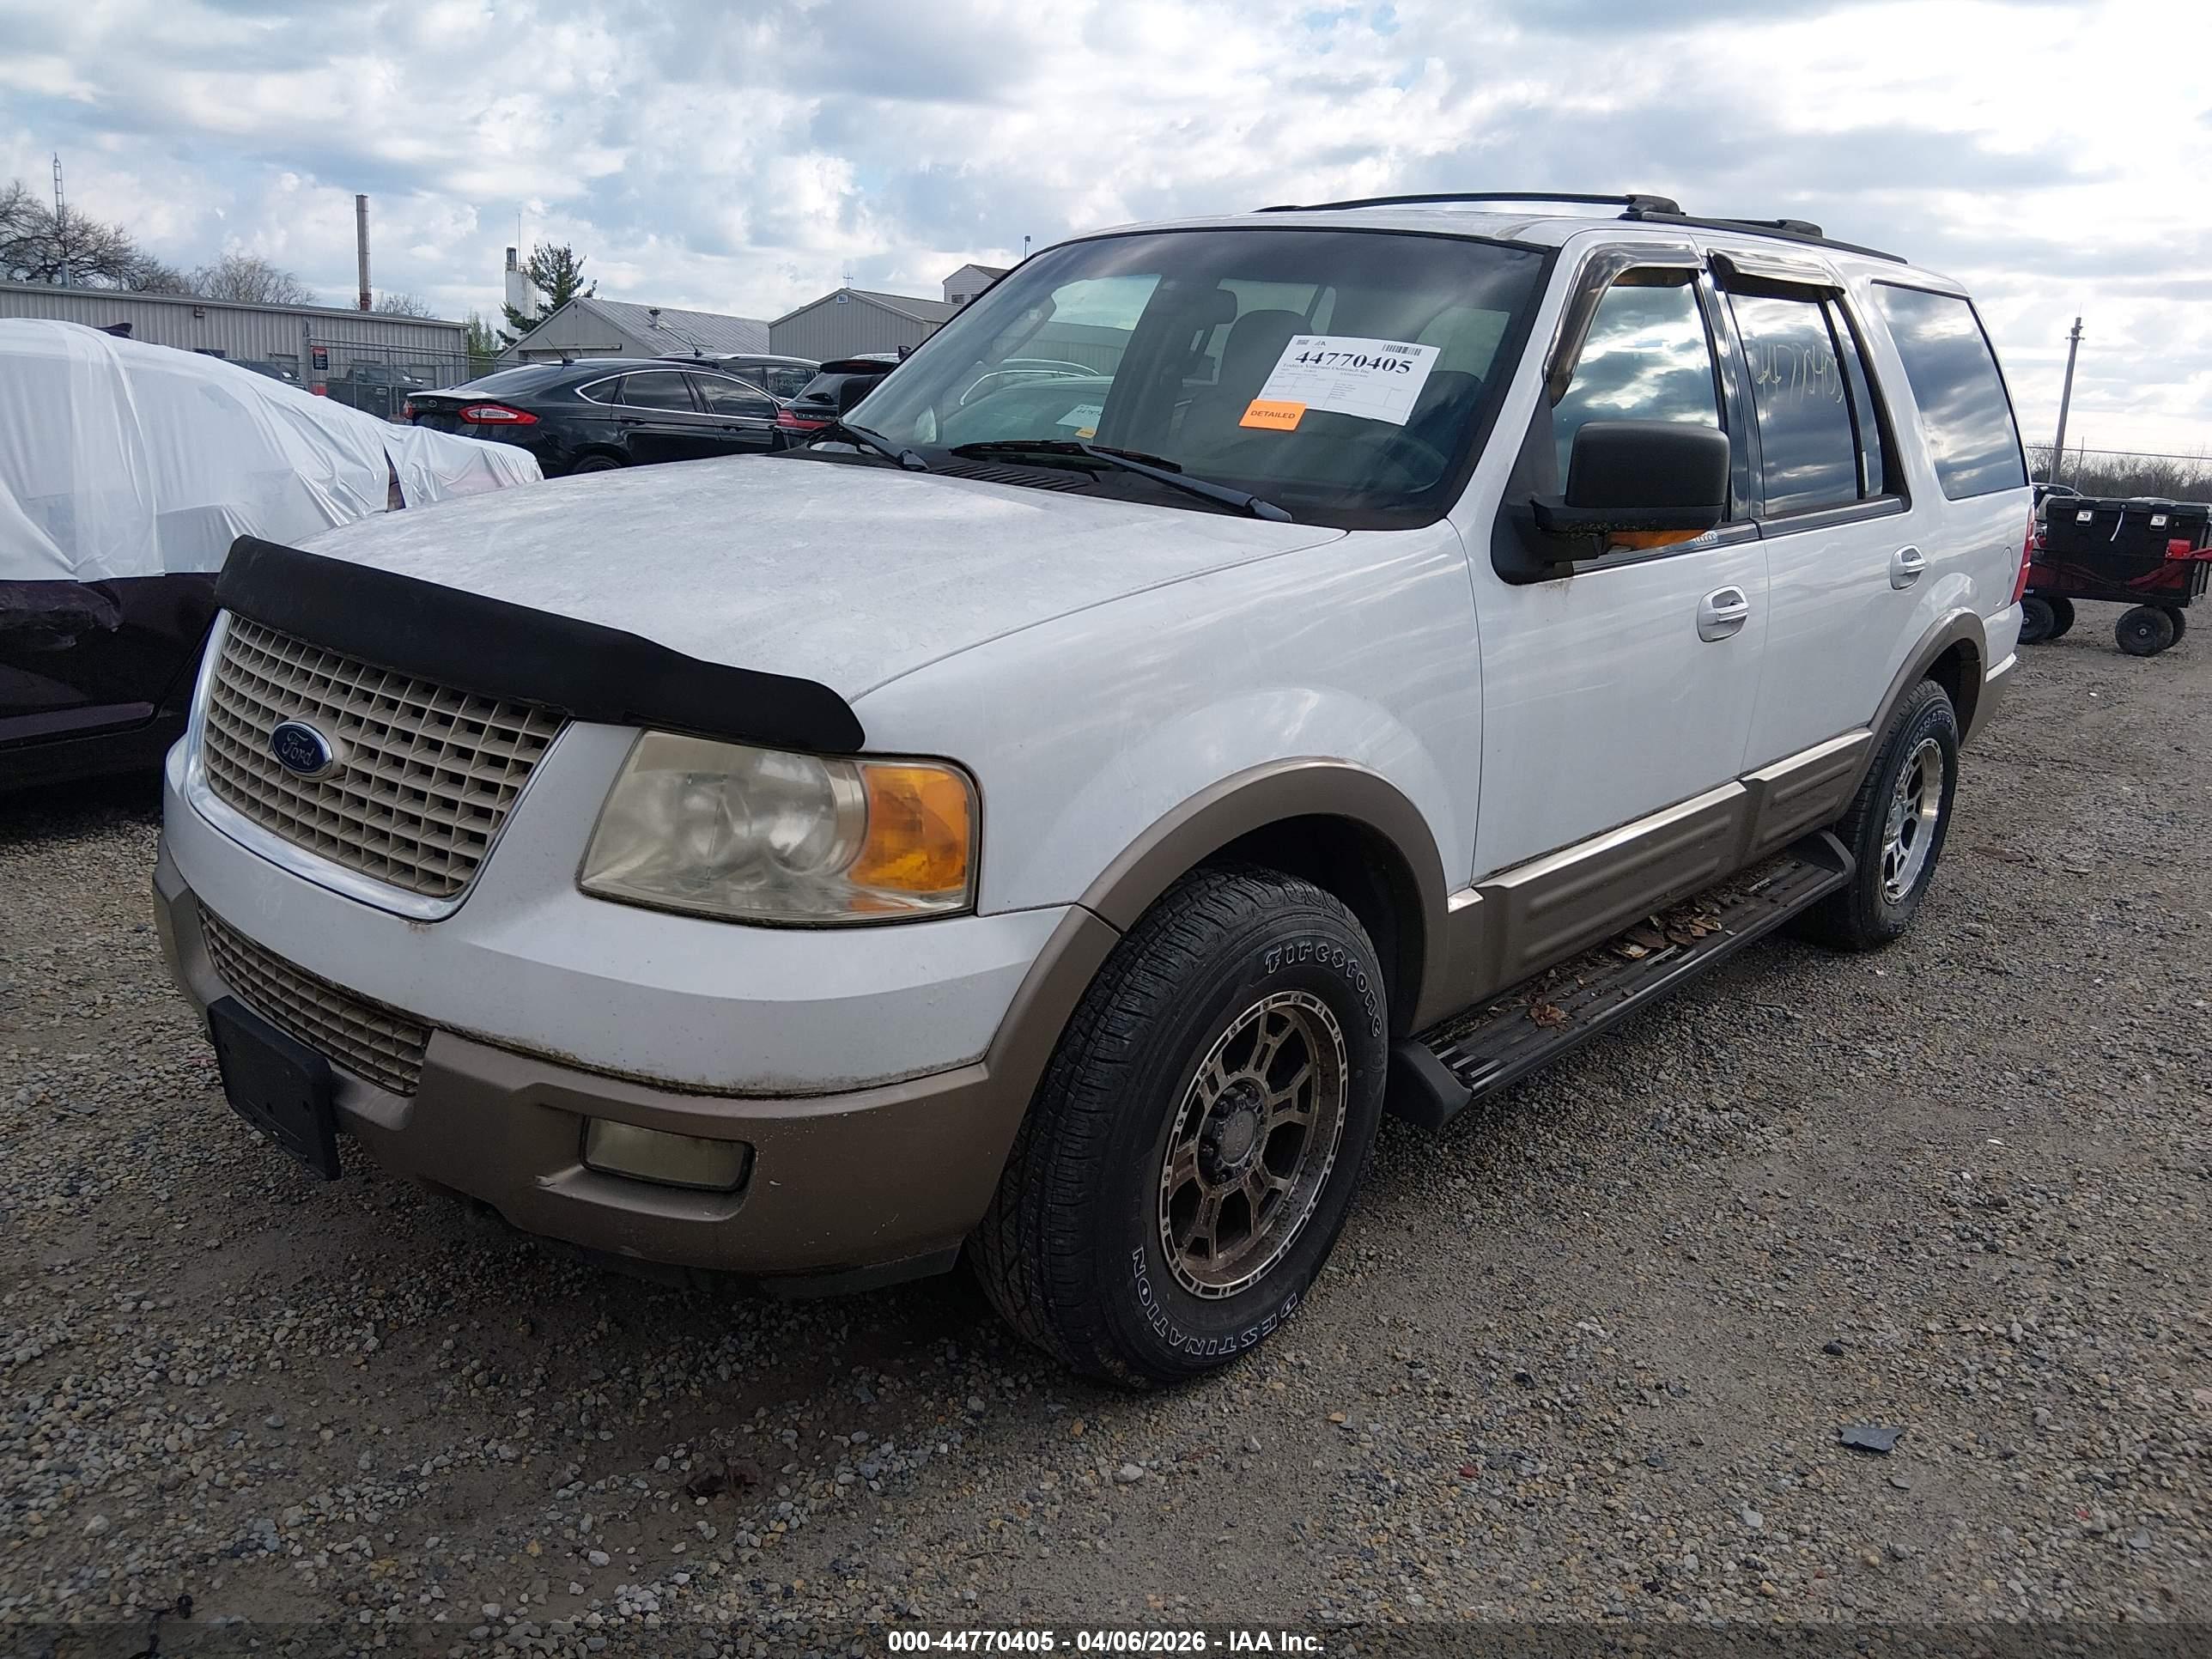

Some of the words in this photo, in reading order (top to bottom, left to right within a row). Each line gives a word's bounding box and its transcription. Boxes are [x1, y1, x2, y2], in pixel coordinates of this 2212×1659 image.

[1294, 350, 1413, 374] 44770405
[1249, 410, 1296, 419] DETAILED
[282, 731, 315, 766] Ford
[1265, 941, 1382, 1037] Firestone
[1132, 1246, 1298, 1356] DESTINATION
